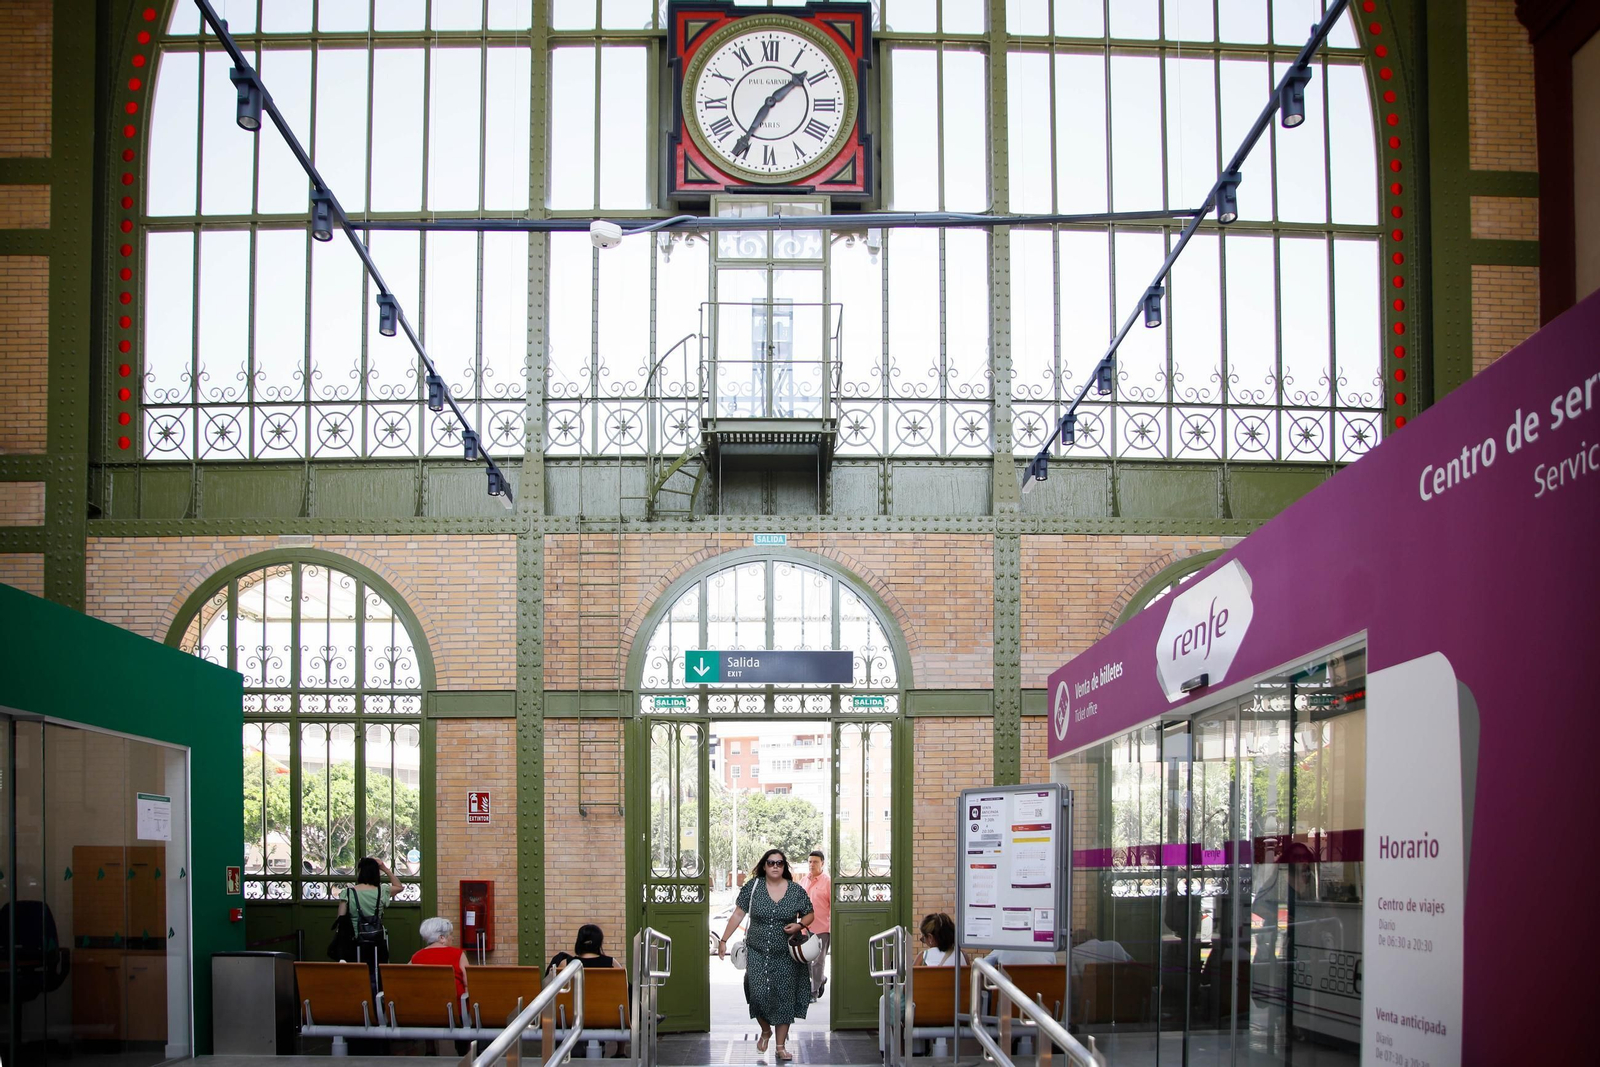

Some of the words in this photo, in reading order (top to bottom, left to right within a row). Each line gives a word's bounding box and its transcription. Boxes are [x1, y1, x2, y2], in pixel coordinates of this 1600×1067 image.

[761, 41, 780, 62] XII
[813, 98, 836, 112] III
[1419, 437, 1497, 501] Centro
[1506, 408, 1539, 454] de
[1550, 372, 1600, 431] ser
[756, 535, 784, 543] SALIDA
[1172, 596, 1229, 661] renfe
[727, 656, 760, 668] Salida
[1074, 680, 1090, 700] Venta
[1091, 672, 1099, 691] de
[1099, 661, 1123, 686] billetes
[1074, 706, 1086, 723] Ticket
[1379, 832, 1439, 859] Horario
[1378, 897, 1404, 911] Centro
[1406, 898, 1417, 912] de
[1419, 898, 1445, 917] viajes
[1378, 918, 1396, 931] Diario
[1378, 934, 1386, 946] De
[1386, 935, 1406, 949] 06:30
[1413, 938, 1433, 952] 20:30
[1375, 1006, 1398, 1025] Venta
[1400, 1014, 1447, 1037] anticipada
[1375, 1031, 1393, 1047] Diario
[1375, 1047, 1383, 1060] De
